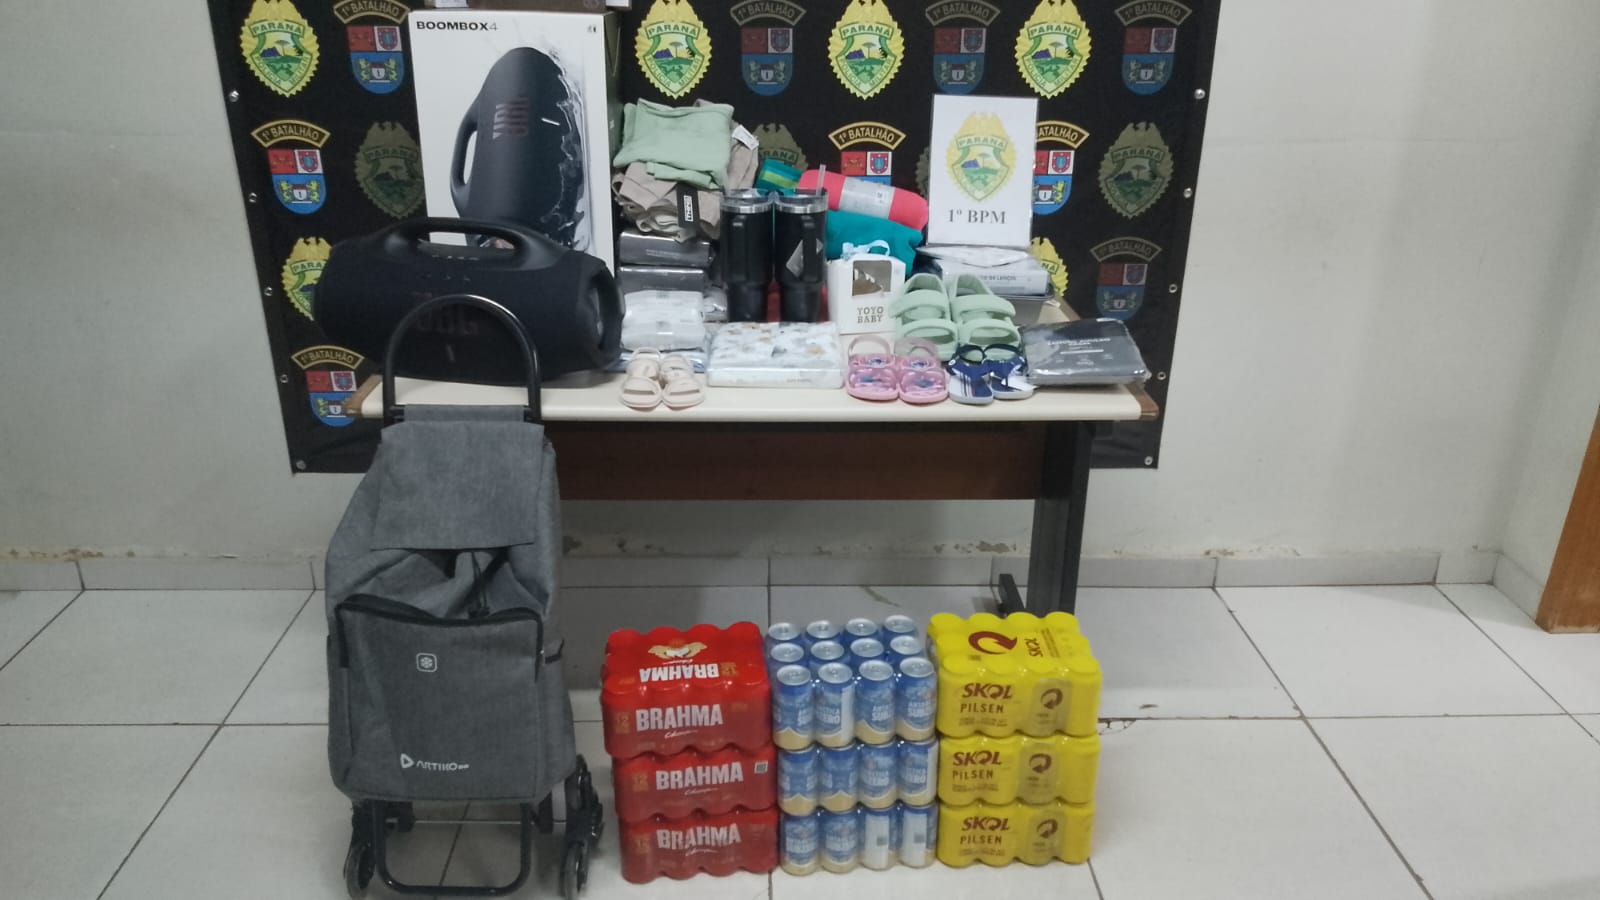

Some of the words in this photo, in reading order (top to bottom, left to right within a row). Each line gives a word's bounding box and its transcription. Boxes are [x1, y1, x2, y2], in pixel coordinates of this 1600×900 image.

[1039, 126, 1079, 142] ATALHÃO
[967, 209, 1007, 224] BPM
[857, 306, 884, 315] YOYO
[857, 315, 884, 324] BABY
[639, 663, 720, 683] BRAHMA
[961, 682, 1014, 700] SKOL
[960, 702, 1004, 714] PILSEN
[635, 703, 724, 732] BRAHMA
[952, 750, 1003, 767] SKOL
[655, 761, 744, 791] BRAHMA
[952, 769, 994, 780] PILSEN
[960, 816, 1010, 832] SKOL
[655, 823, 742, 851] BRAHMA
[960, 835, 1003, 845] PILSEN
